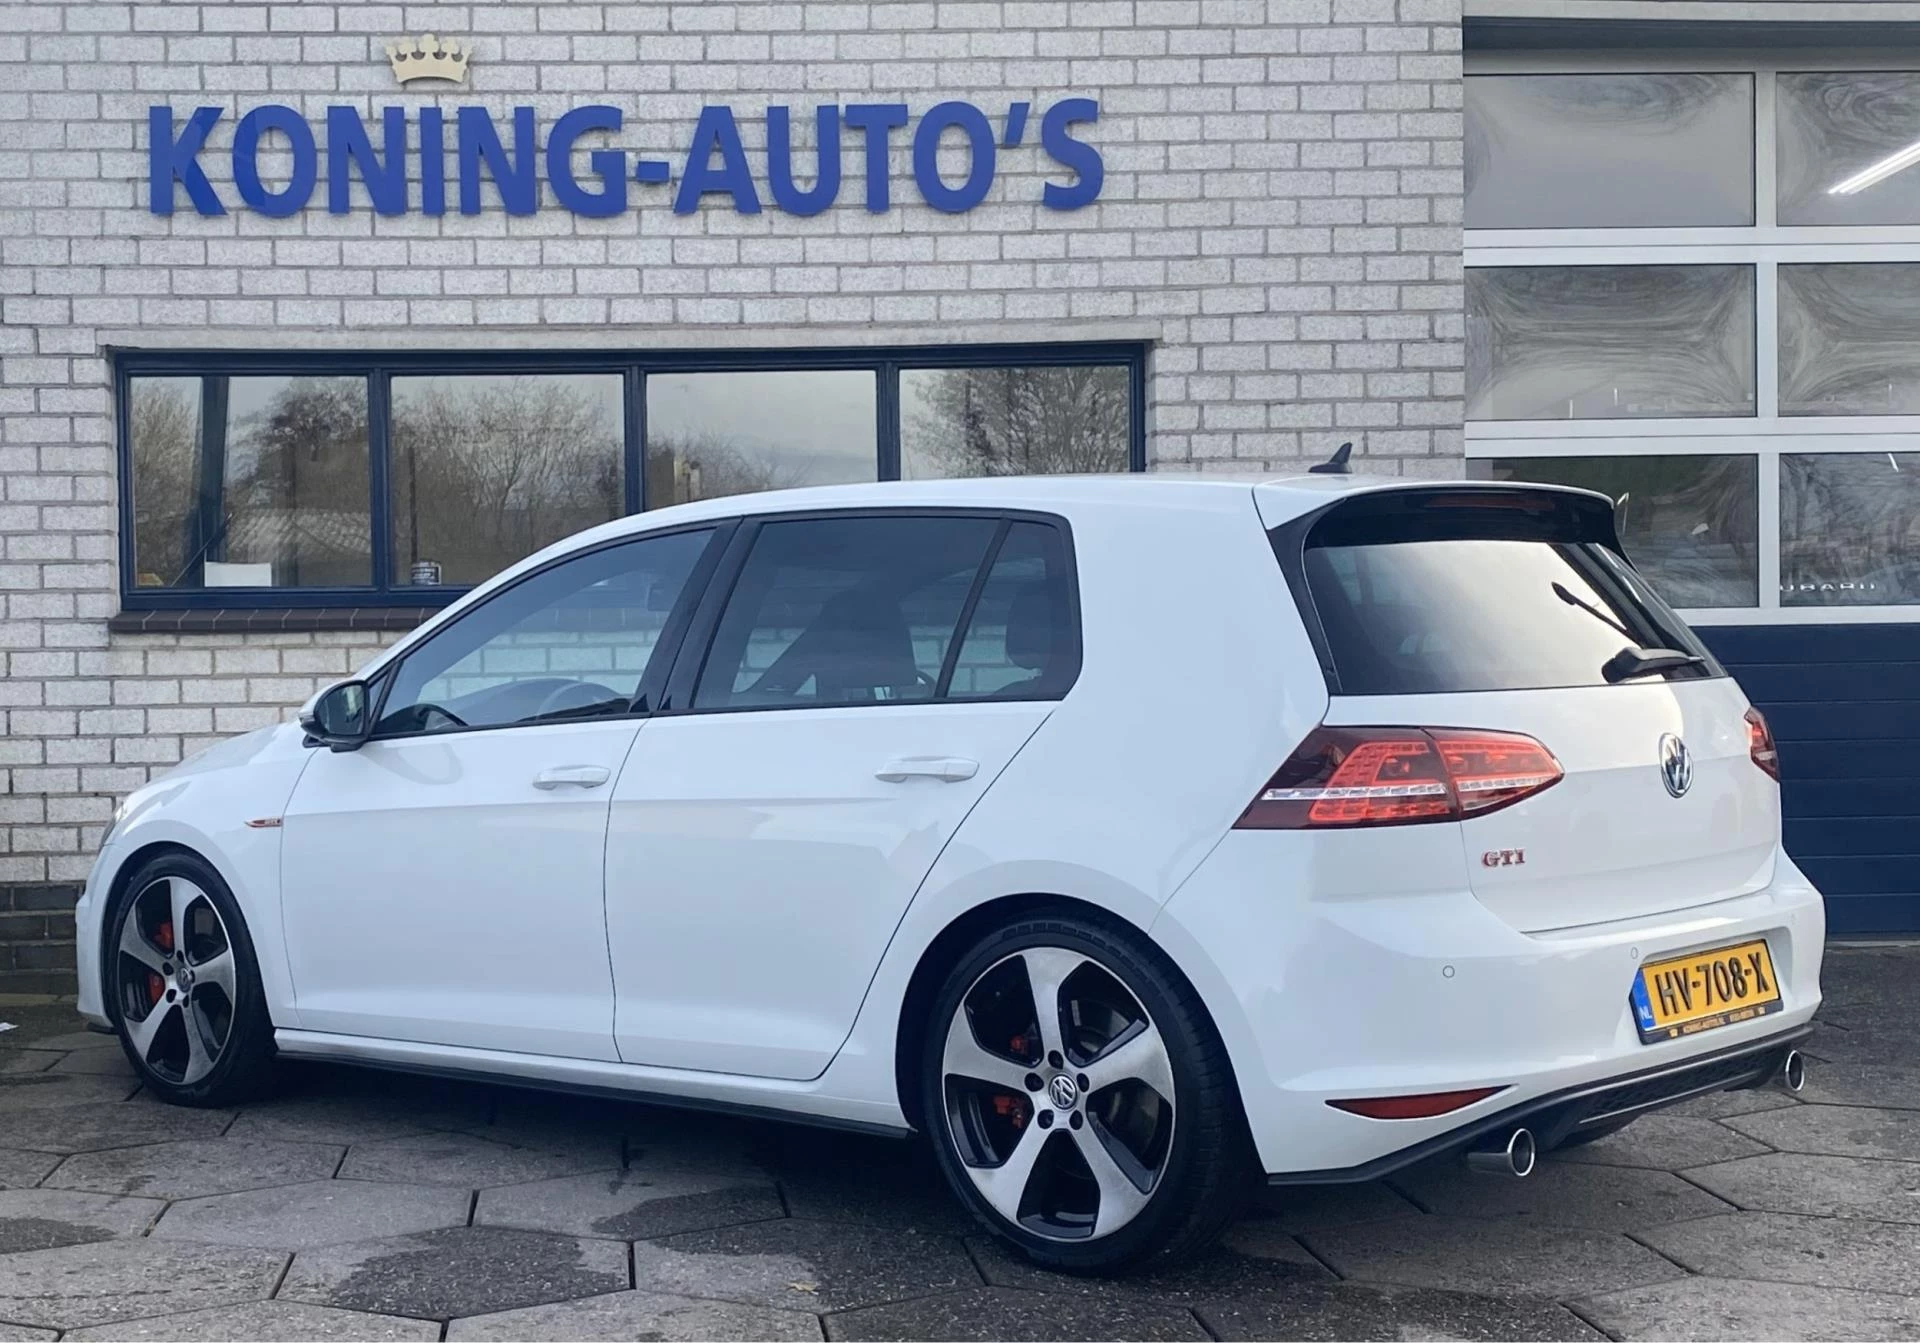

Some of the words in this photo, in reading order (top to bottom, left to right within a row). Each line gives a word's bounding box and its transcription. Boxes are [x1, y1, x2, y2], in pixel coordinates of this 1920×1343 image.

[149, 98, 1103, 218] KONING-AUTO'S
[1481, 848, 1526, 867] GTI
[1654, 951, 1770, 1017] HV-708-X
[1639, 1005, 1654, 1021] NL
